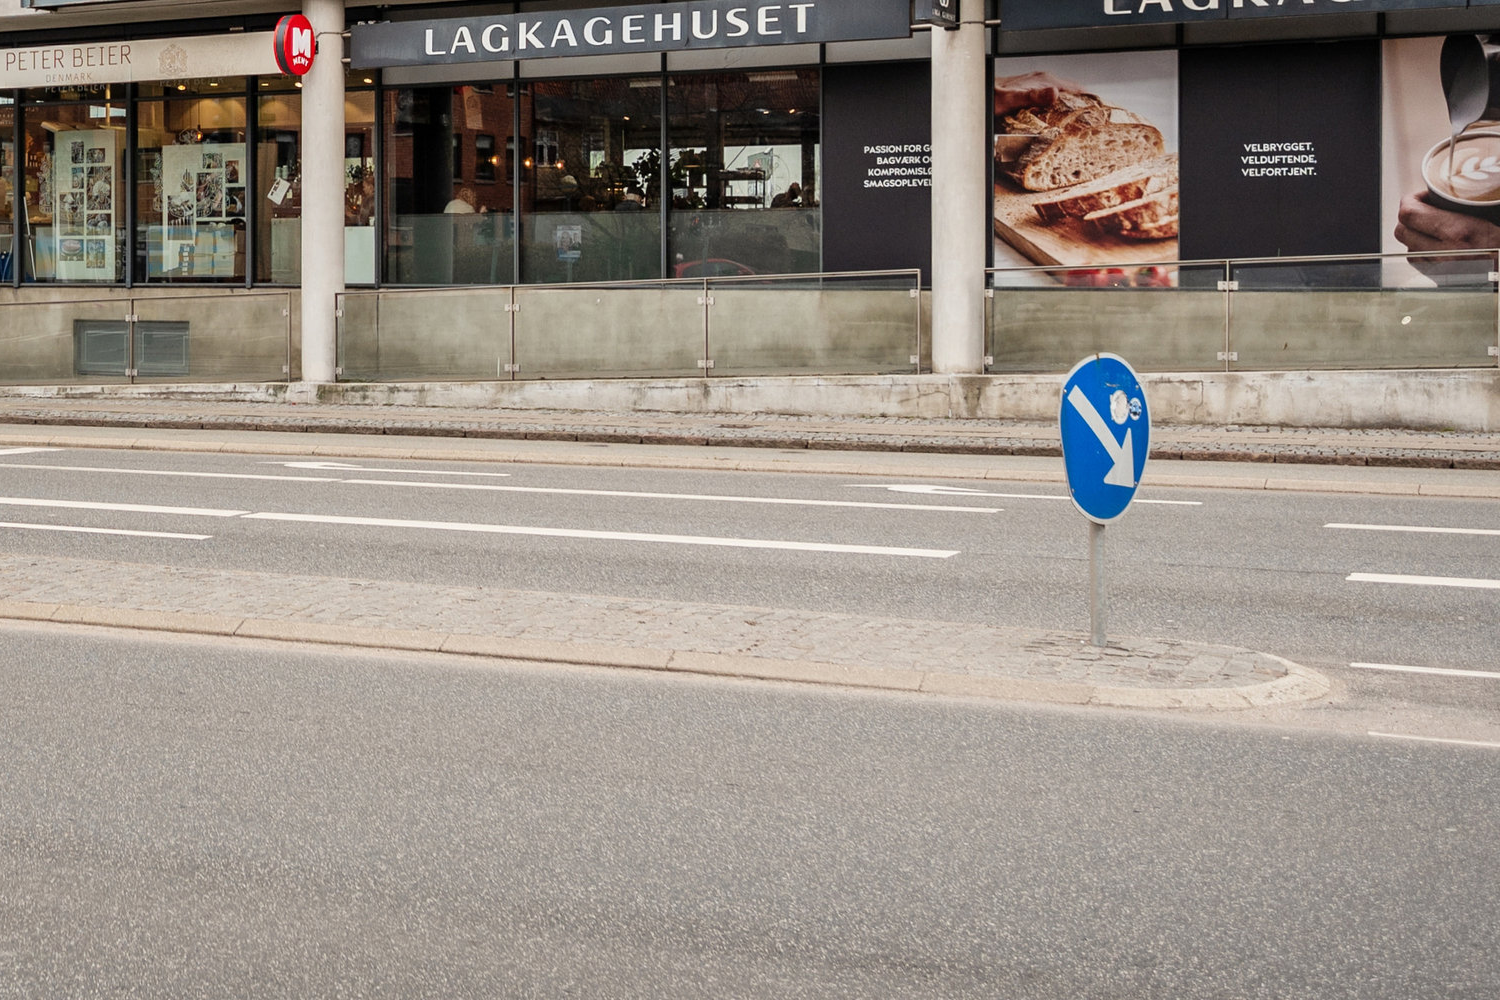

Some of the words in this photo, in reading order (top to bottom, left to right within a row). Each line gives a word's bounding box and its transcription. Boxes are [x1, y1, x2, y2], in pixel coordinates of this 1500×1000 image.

[425, 3, 815, 56] LAGKAGEHUSET
[292, 27, 311, 58] M
[6, 49, 64, 71] PETER
[73, 45, 131, 68] BEIER
[292, 56, 308, 67] MENY
[45, 72, 92, 83] DENMARK
[863, 145, 902, 154] PASSION
[903, 144, 922, 153] FOR
[923, 144, 932, 152] G
[1243, 142, 1314, 152] VELBRYGGET,
[876, 156, 921, 165] BAGVÆRK
[922, 155, 932, 163] O
[1241, 154, 1317, 165] VELDUFTENDE,
[1241, 167, 1317, 176] VELFORTJENT.
